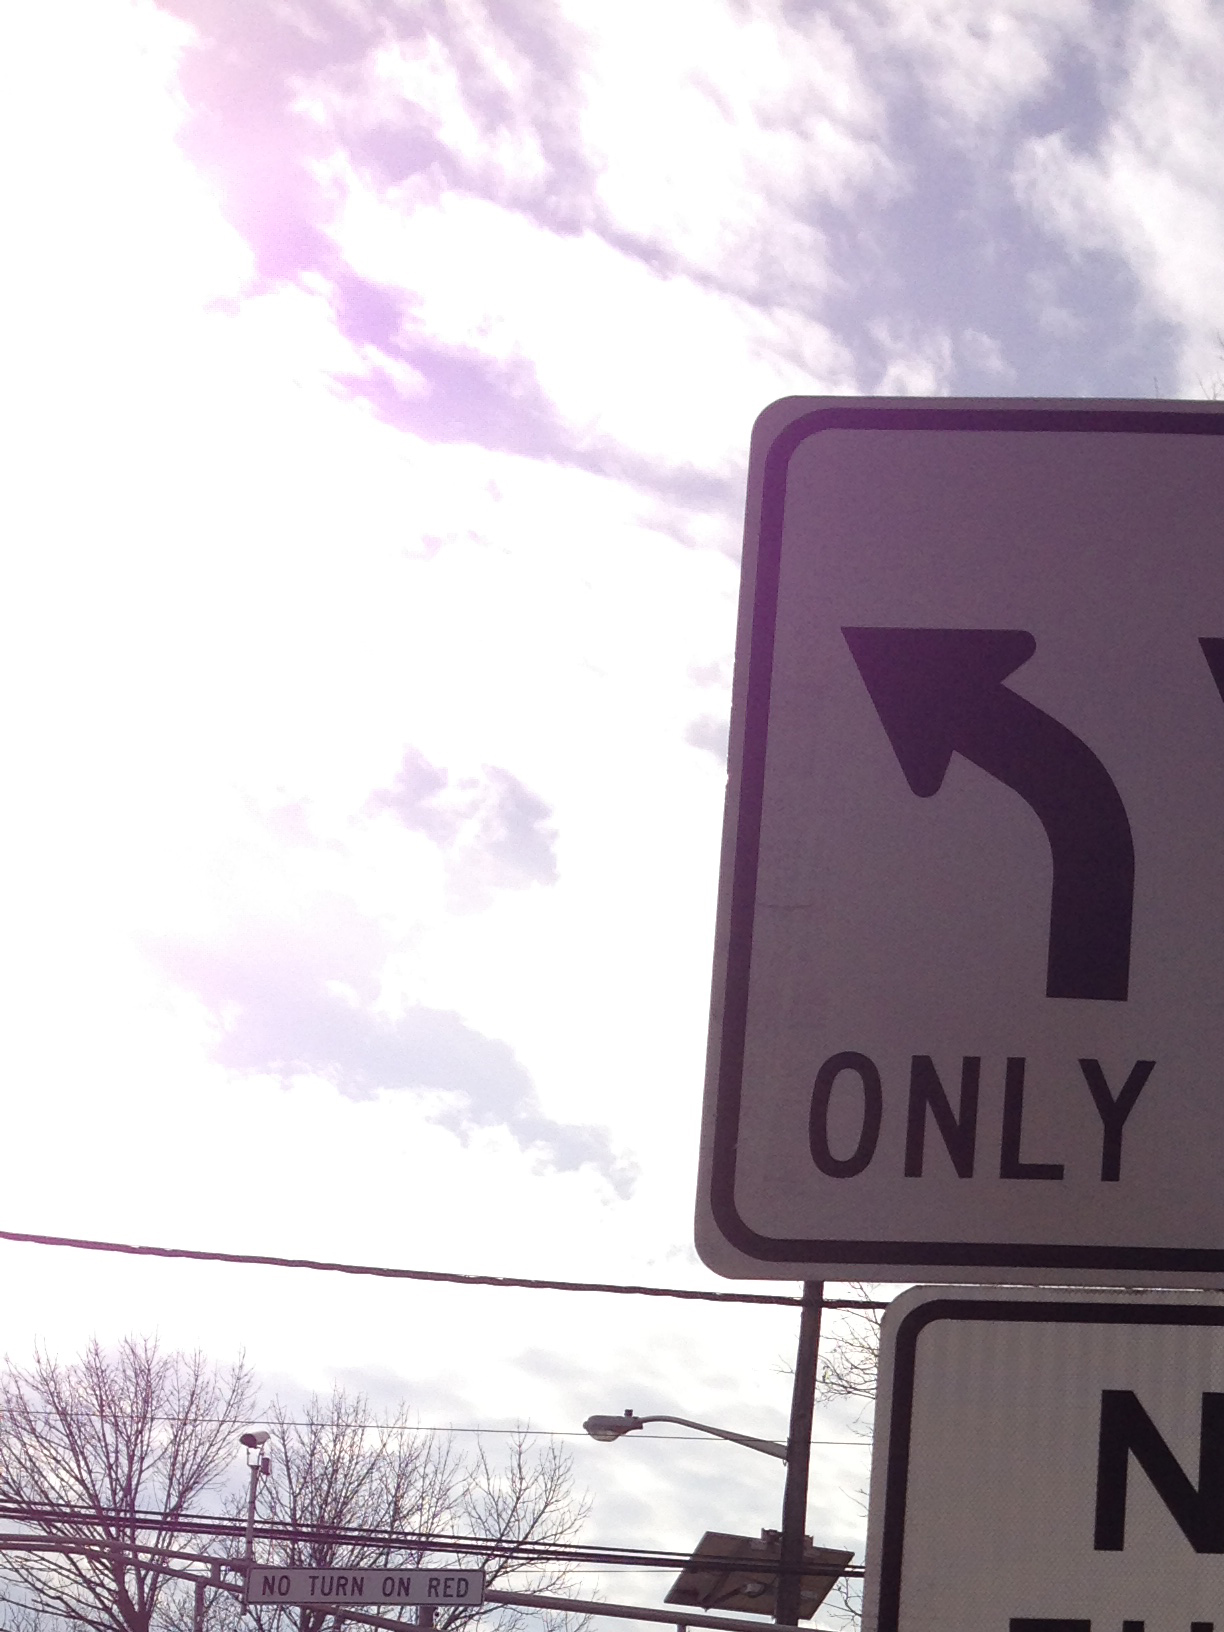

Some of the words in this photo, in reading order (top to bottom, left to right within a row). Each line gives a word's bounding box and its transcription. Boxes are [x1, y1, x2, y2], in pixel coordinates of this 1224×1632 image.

[809, 1051, 1156, 1182] ONLY
[261, 1574, 291, 1597] NO
[308, 1575, 364, 1597] TURN
[382, 1576, 410, 1598] ON
[427, 1577, 469, 1598] RED
